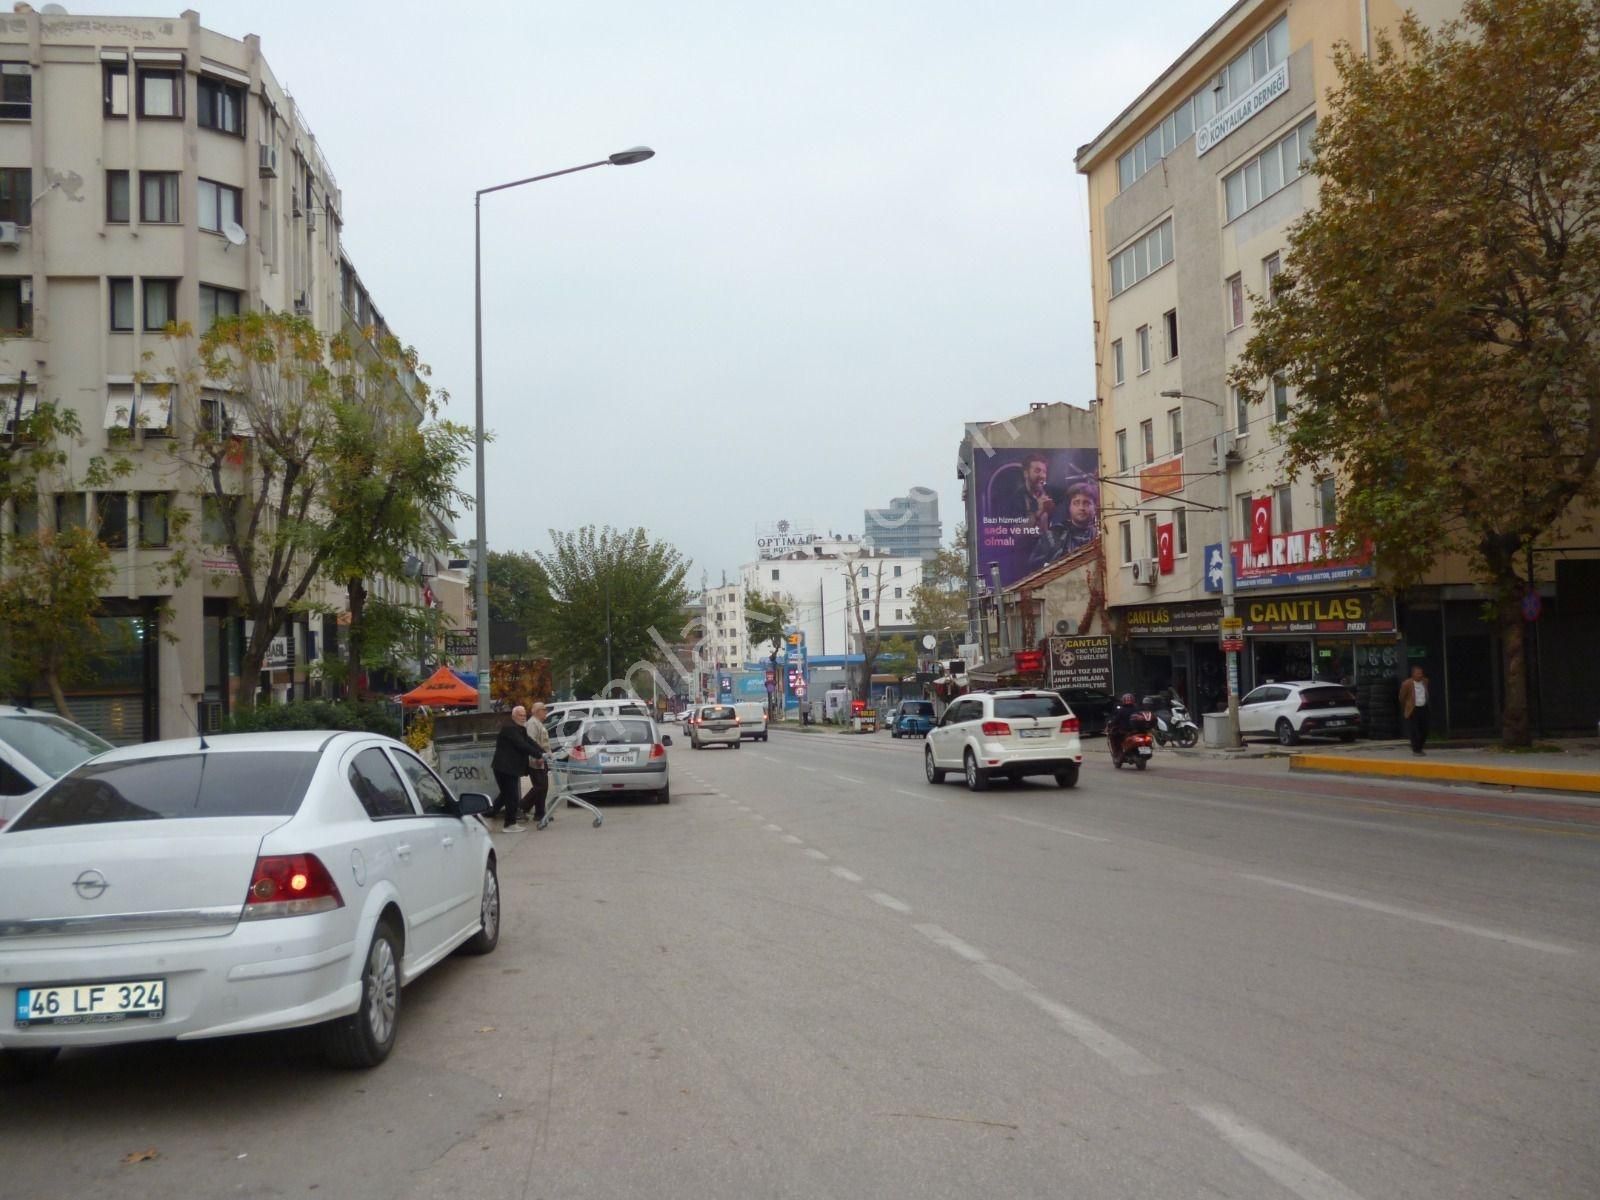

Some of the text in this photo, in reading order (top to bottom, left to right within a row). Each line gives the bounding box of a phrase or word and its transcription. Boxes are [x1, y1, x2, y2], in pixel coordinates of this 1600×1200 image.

[1210, 71, 1285, 143] KONYALILAR DERNEĞİ
[983, 516, 1030, 524] Bazı hizmetler
[985, 526, 1008, 535] sade
[1023, 526, 1040, 535] net
[984, 537, 1015, 546] olmalı
[1127, 608, 1170, 625] CANTLAS
[1250, 598, 1362, 622] CANTLAS
[1066, 638, 1108, 648] CANTLAS
[31, 984, 160, 1015] 46 LF 324
